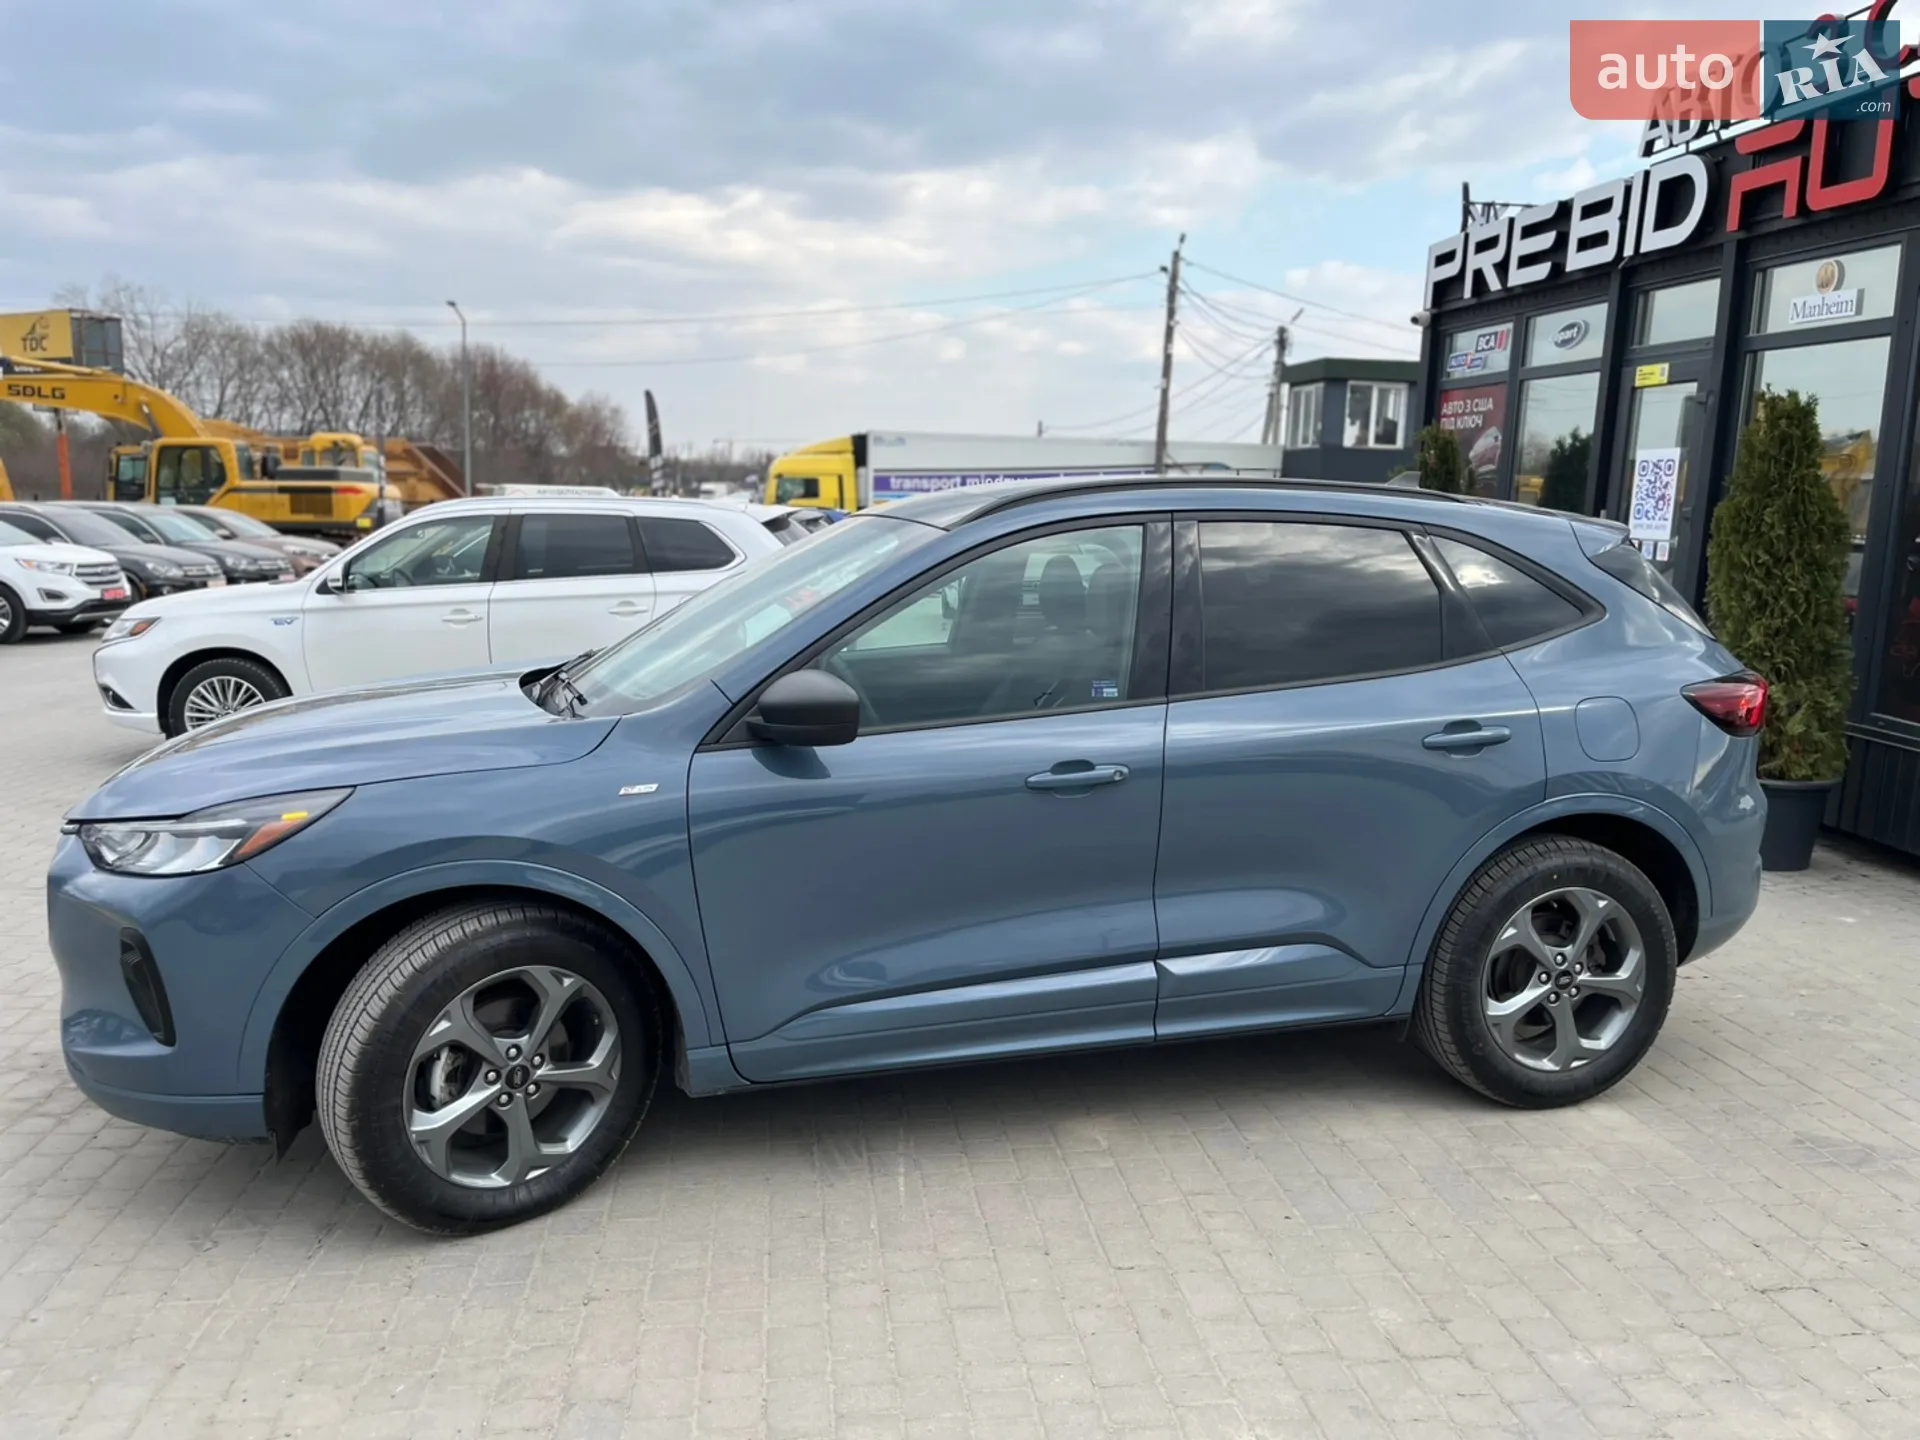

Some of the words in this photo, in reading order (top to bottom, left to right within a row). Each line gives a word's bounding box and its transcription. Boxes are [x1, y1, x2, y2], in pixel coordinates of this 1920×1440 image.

[1423, 154, 1709, 310] PREBID
[1789, 295, 1855, 321] Manheim
[1477, 334, 1496, 351] BCA
[7, 384, 66, 400] SDLG
[1441, 400, 1464, 416] АВТО
[1473, 397, 1494, 412] США
[889, 476, 961, 492] transport
